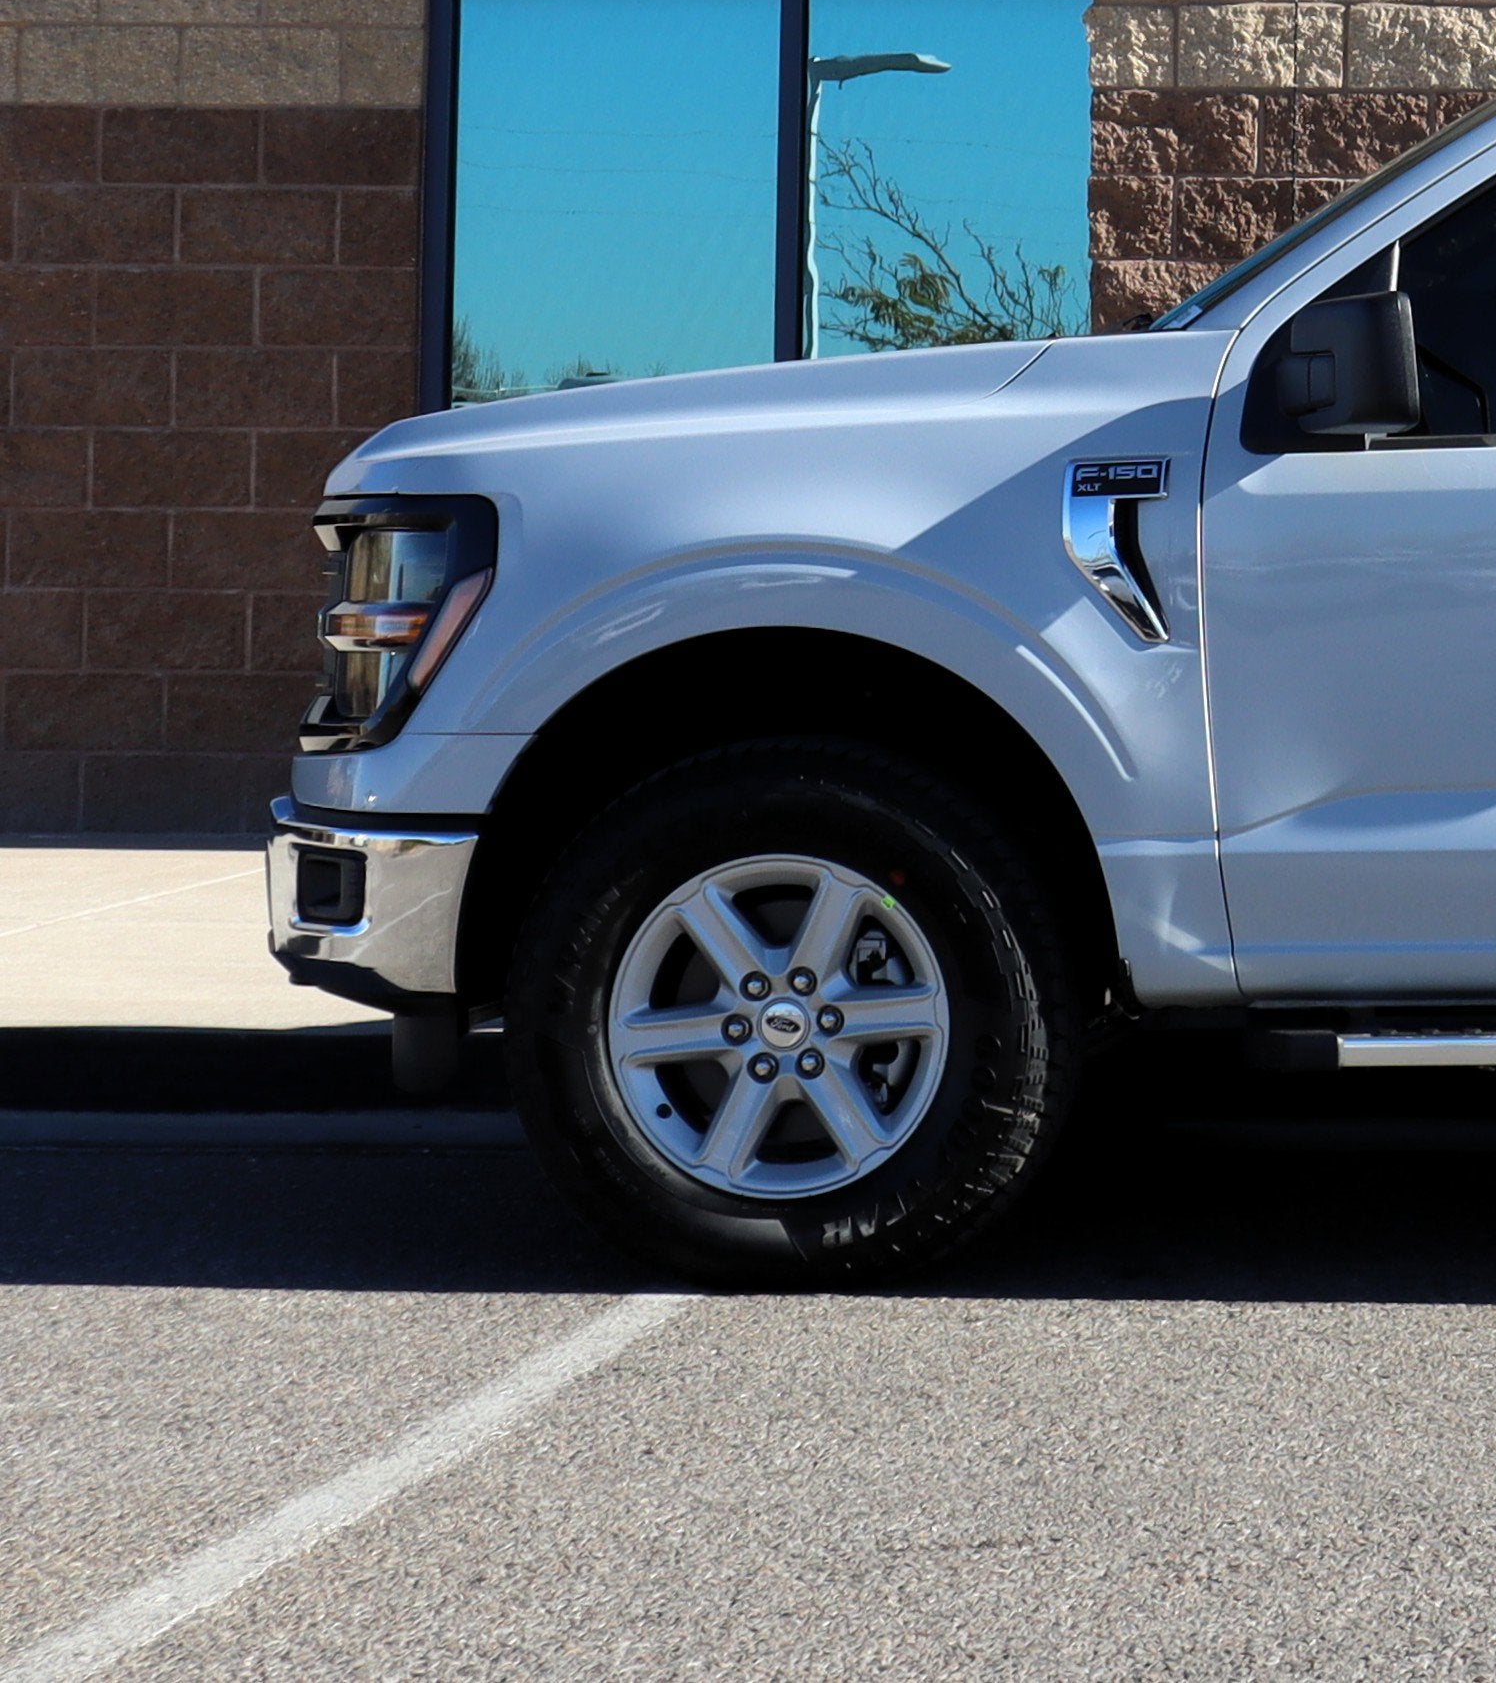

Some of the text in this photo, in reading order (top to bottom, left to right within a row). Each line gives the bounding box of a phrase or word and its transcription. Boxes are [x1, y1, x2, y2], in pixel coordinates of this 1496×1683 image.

[1076, 465, 1159, 481] F-150
[1077, 483, 1101, 492] XLT
[769, 1017, 797, 1032] Ford
[822, 1034, 1002, 1249] GOODEAR
